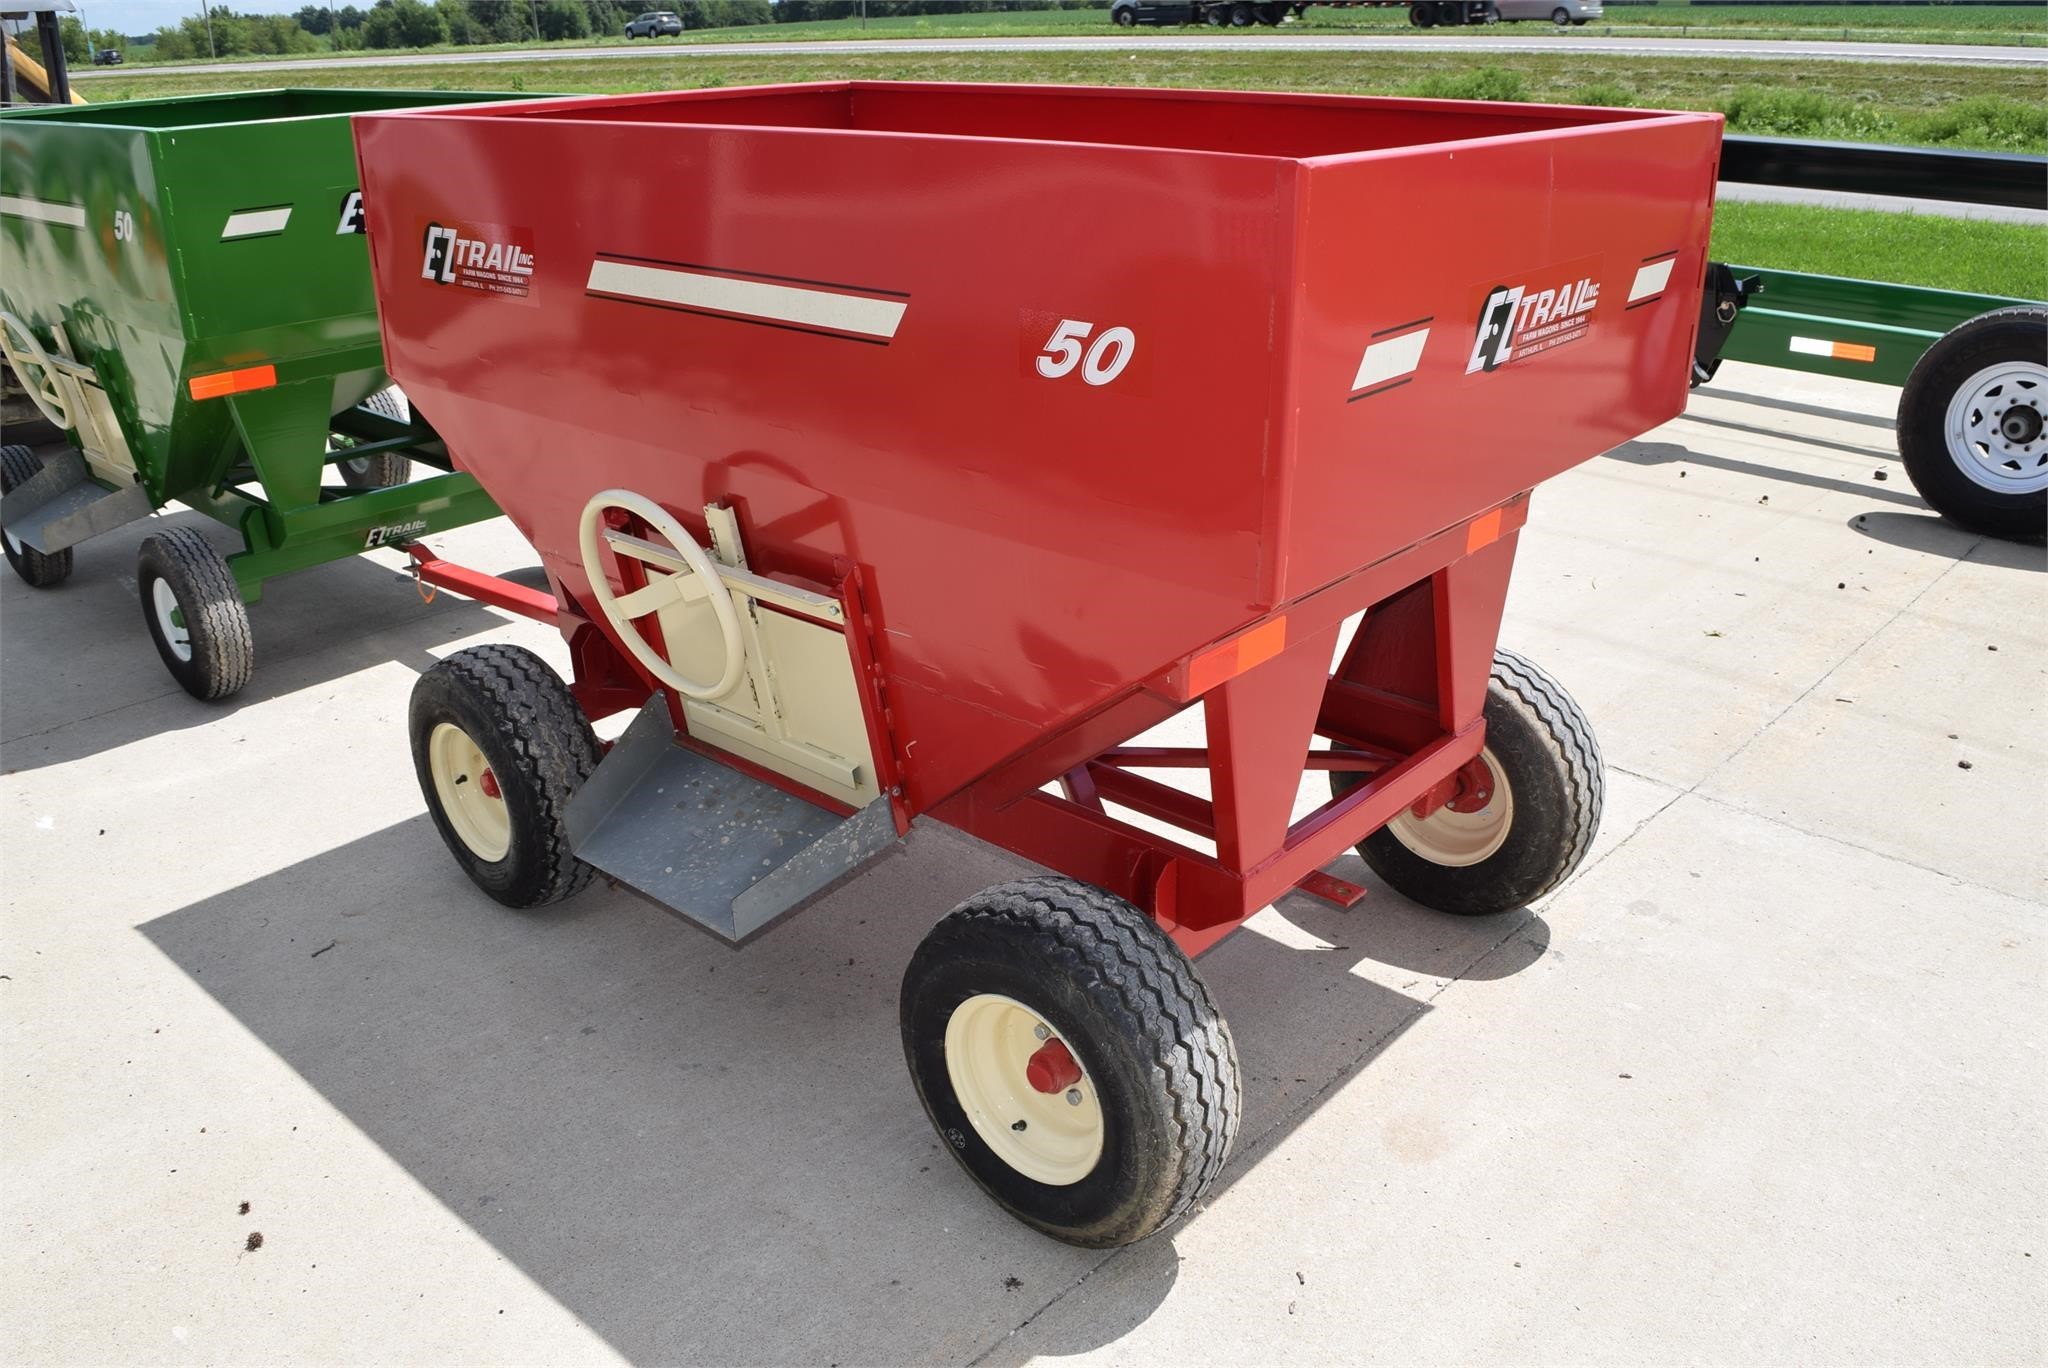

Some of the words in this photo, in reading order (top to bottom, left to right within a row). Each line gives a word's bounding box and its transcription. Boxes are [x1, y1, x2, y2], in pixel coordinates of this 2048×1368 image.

[114, 210, 133, 242] 50
[336, 191, 363, 235] E
[456, 238, 533, 275] TRAIL
[518, 253, 535, 266] INC.
[476, 271, 497, 280] WAGONS
[497, 273, 512, 283] SINCE
[1517, 278, 1597, 332] TRAIL
[1523, 330, 1538, 342] FARM
[1538, 323, 1560, 337] WAGONS
[1560, 317, 1575, 330] SINCE
[1036, 319, 1135, 386] 50
[385, 521, 426, 537] TRAIL
